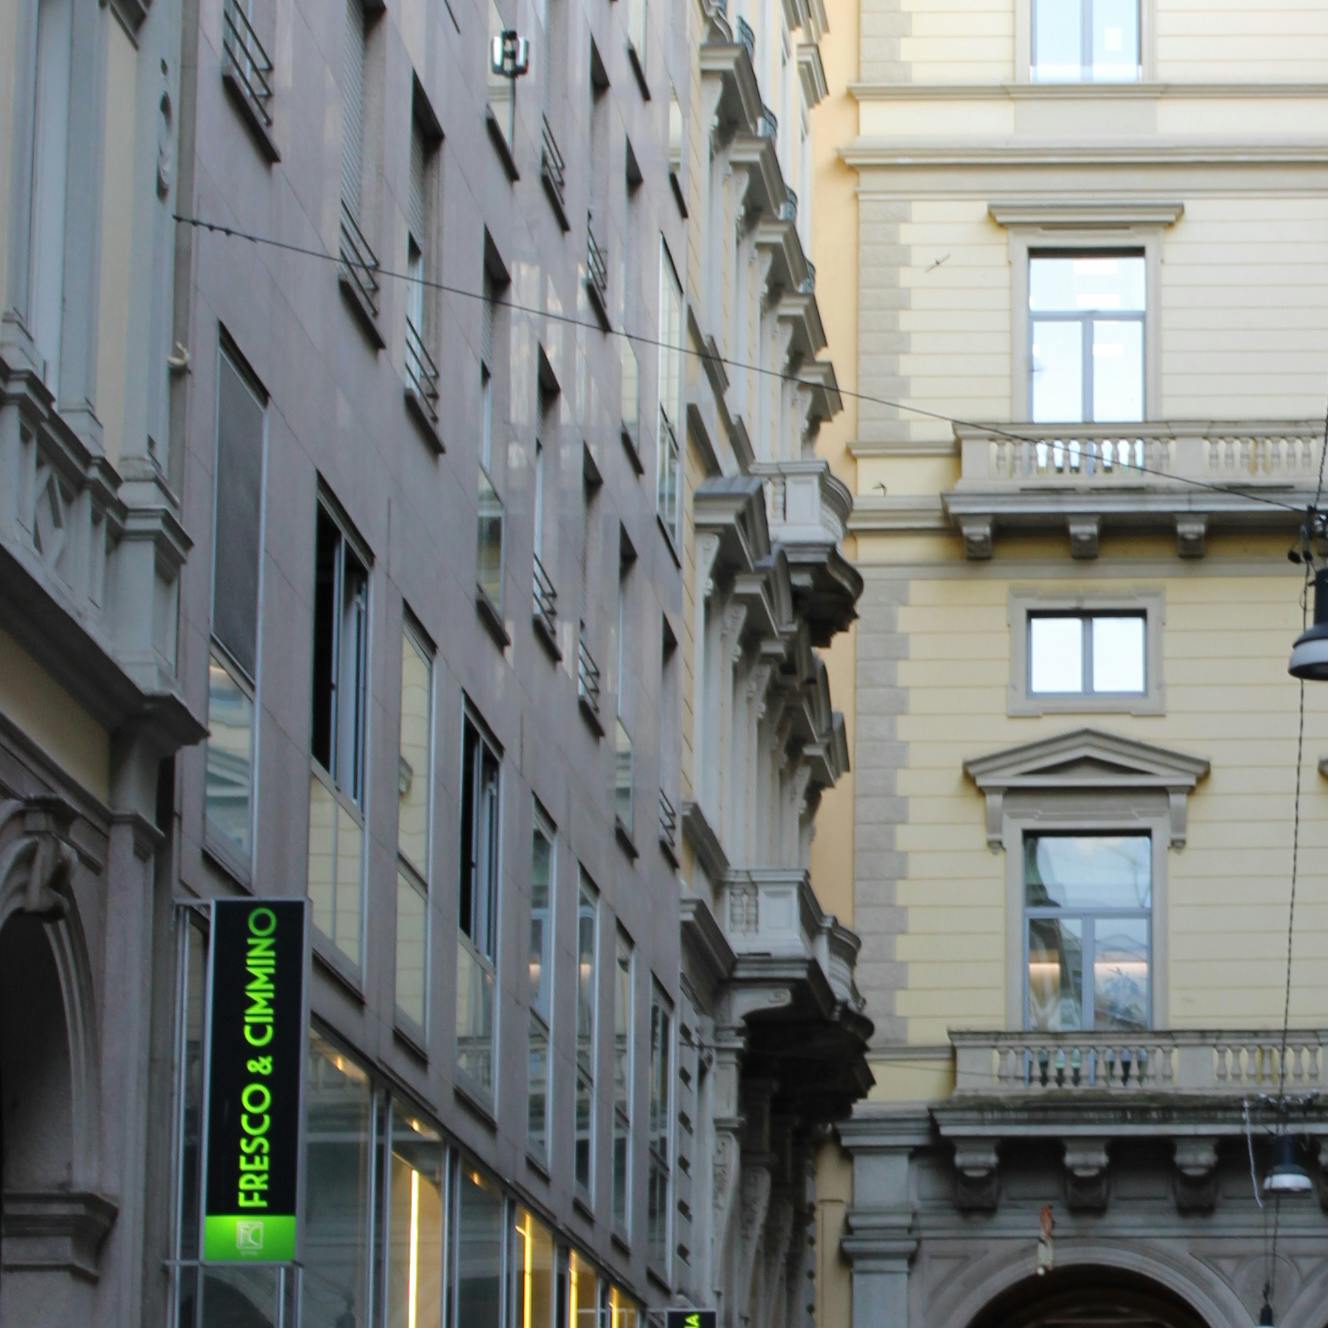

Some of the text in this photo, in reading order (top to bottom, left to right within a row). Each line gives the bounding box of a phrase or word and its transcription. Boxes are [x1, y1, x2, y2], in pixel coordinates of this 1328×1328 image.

[243, 907, 277, 1048] CIMMINO
[246, 1055, 273, 1076] &
[238, 1083, 272, 1208] FRESCO
